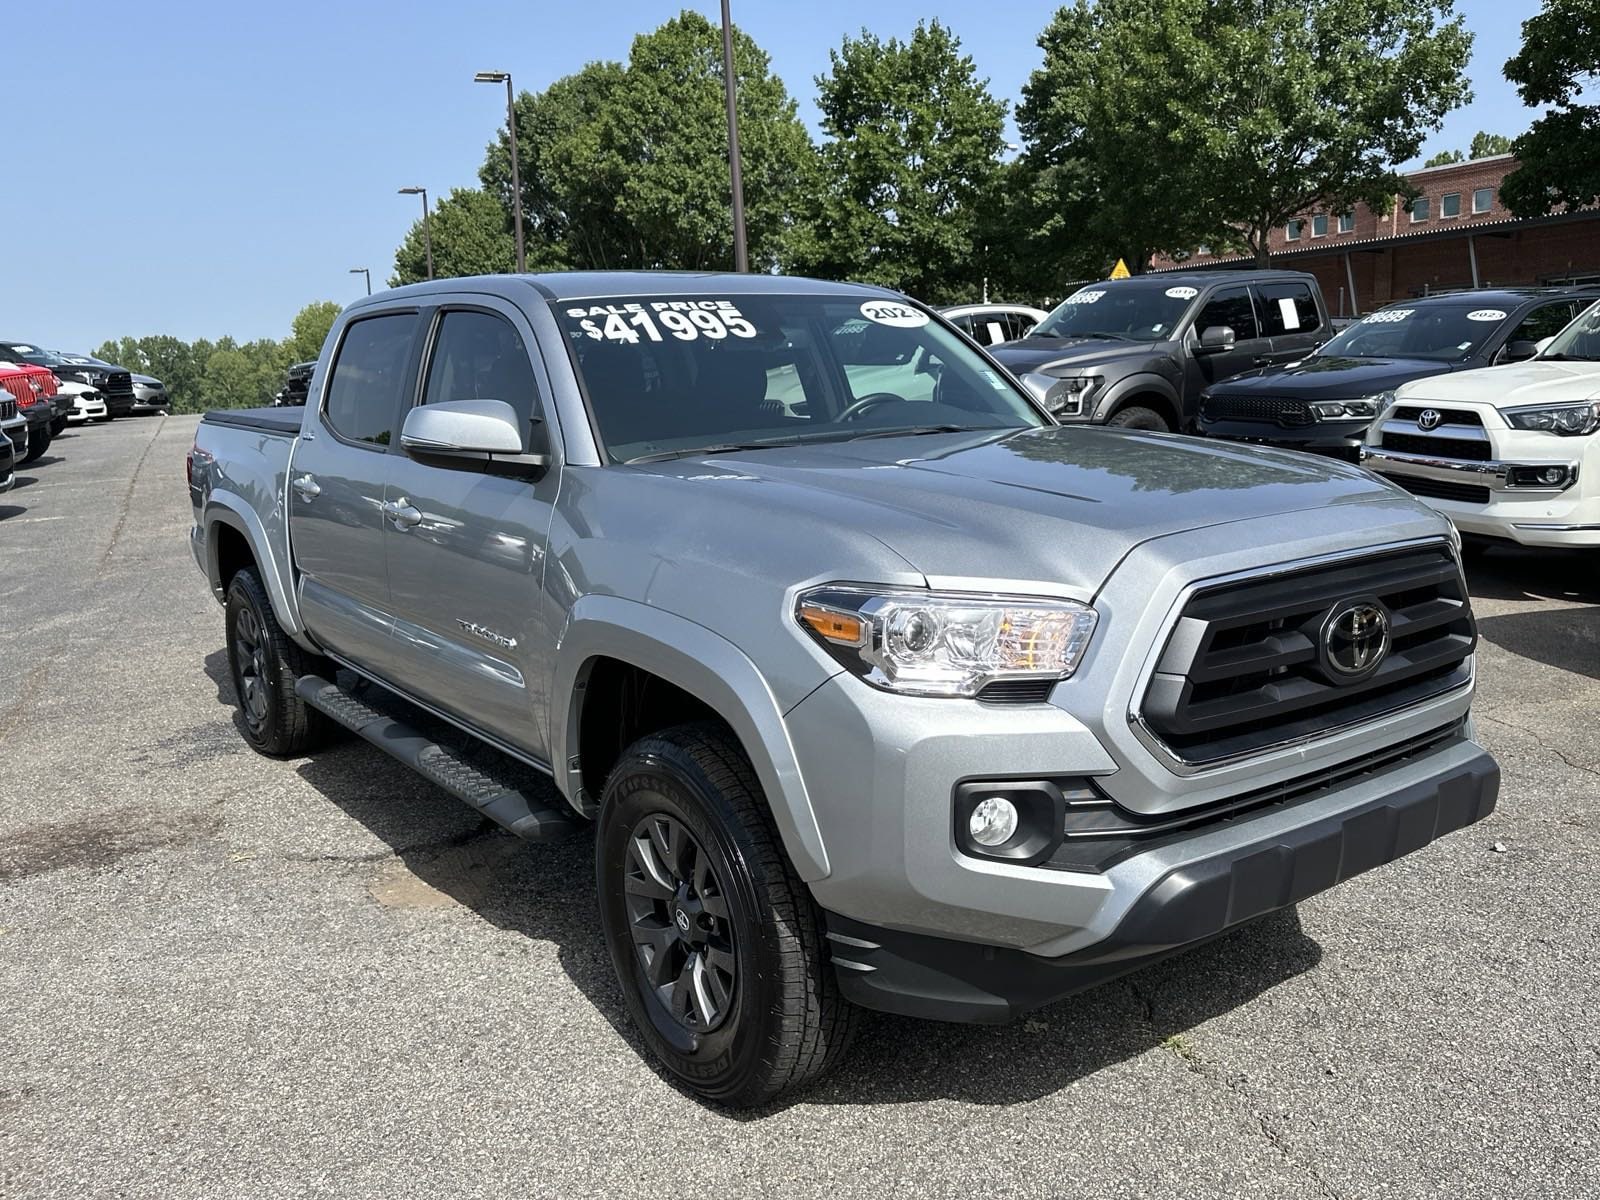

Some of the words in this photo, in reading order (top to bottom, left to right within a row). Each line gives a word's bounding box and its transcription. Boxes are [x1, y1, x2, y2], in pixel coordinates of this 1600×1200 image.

[566, 303, 645, 318] SALE
[651, 300, 736, 312] PRICE
[580, 309, 757, 343] $41995
